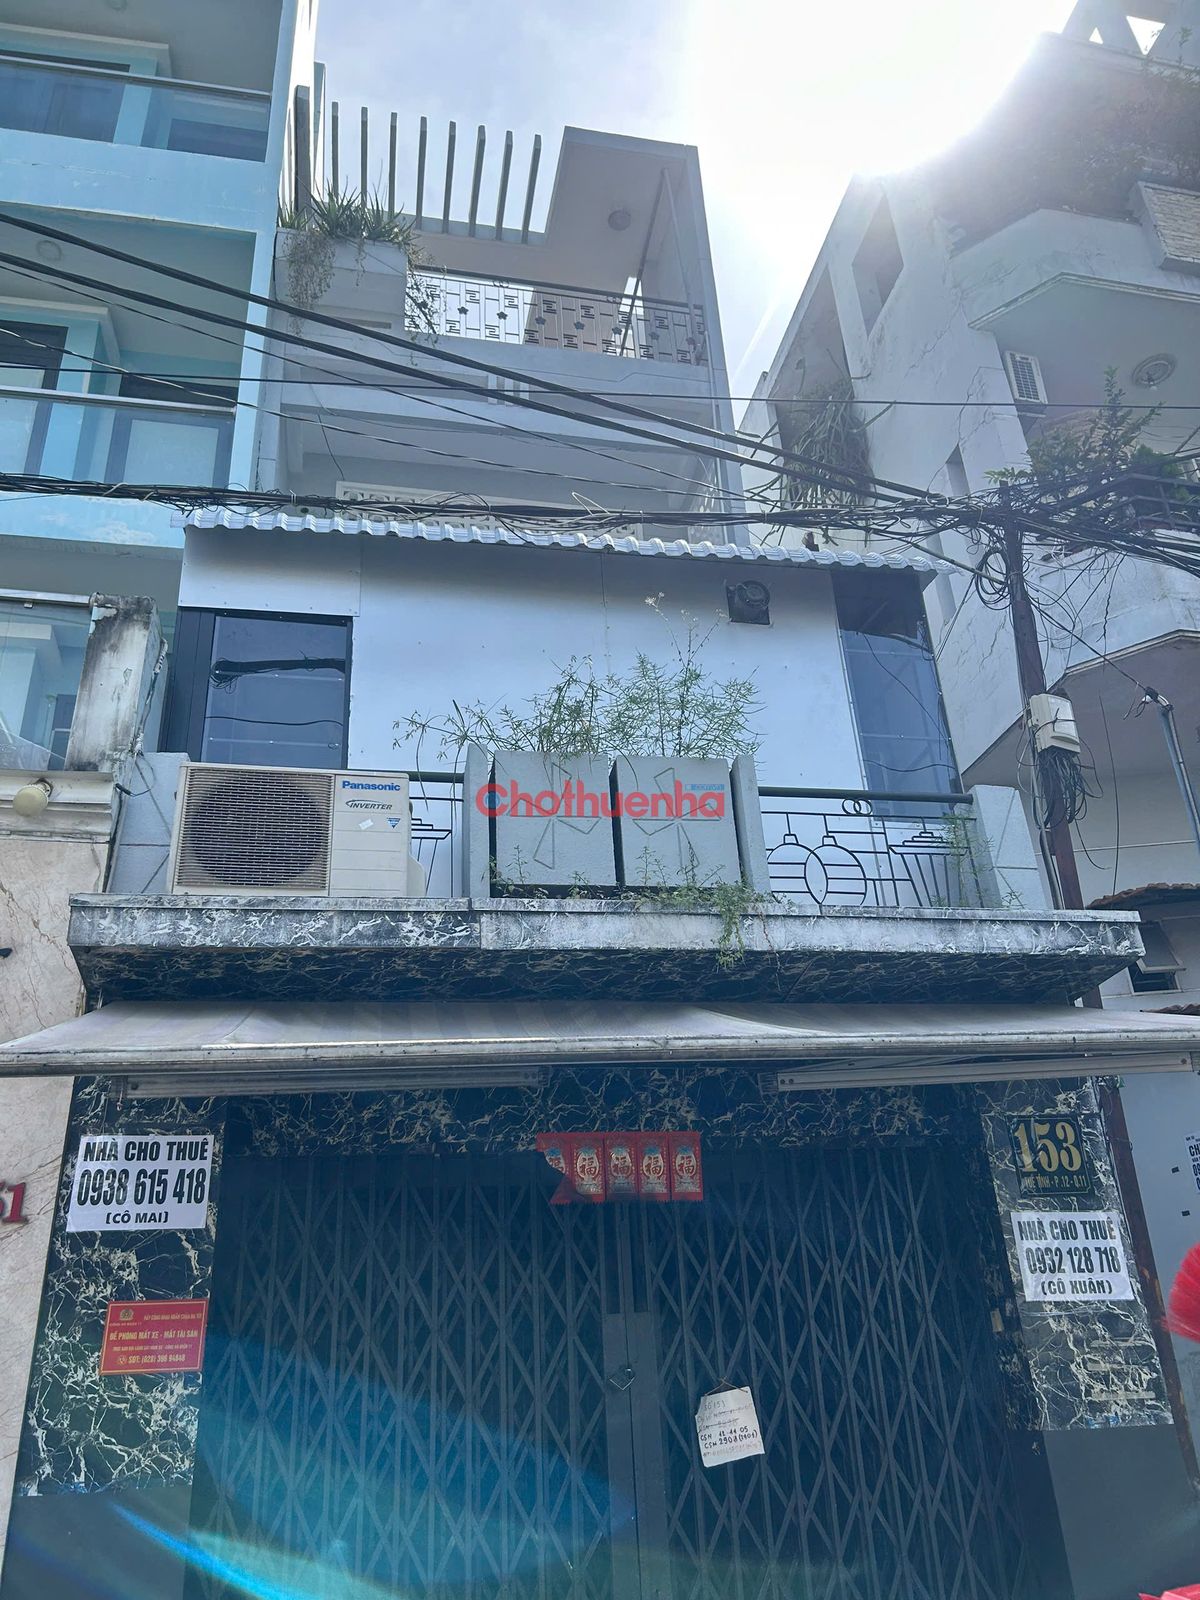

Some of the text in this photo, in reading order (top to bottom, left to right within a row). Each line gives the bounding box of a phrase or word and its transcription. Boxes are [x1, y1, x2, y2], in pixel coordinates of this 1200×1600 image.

[342, 780, 400, 791] Panasonic
[350, 802, 392, 810] INVERTER
[84, 1138, 209, 1161] NHÀ CHO THUÊ
[1014, 1122, 1082, 1172] 153
[580, 1157, 596, 1176] 福
[613, 1157, 630, 1176] 福
[645, 1156, 662, 1174] 福
[678, 1156, 695, 1174] 福
[77, 1168, 207, 1206] 0938 615 418
[1017, 1216, 1116, 1241] NHÀ CHO THUÊ
[1026, 1246, 1122, 1275] 0932 128 718
[1041, 1278, 1113, 1295] (CÔ XUÂN)
